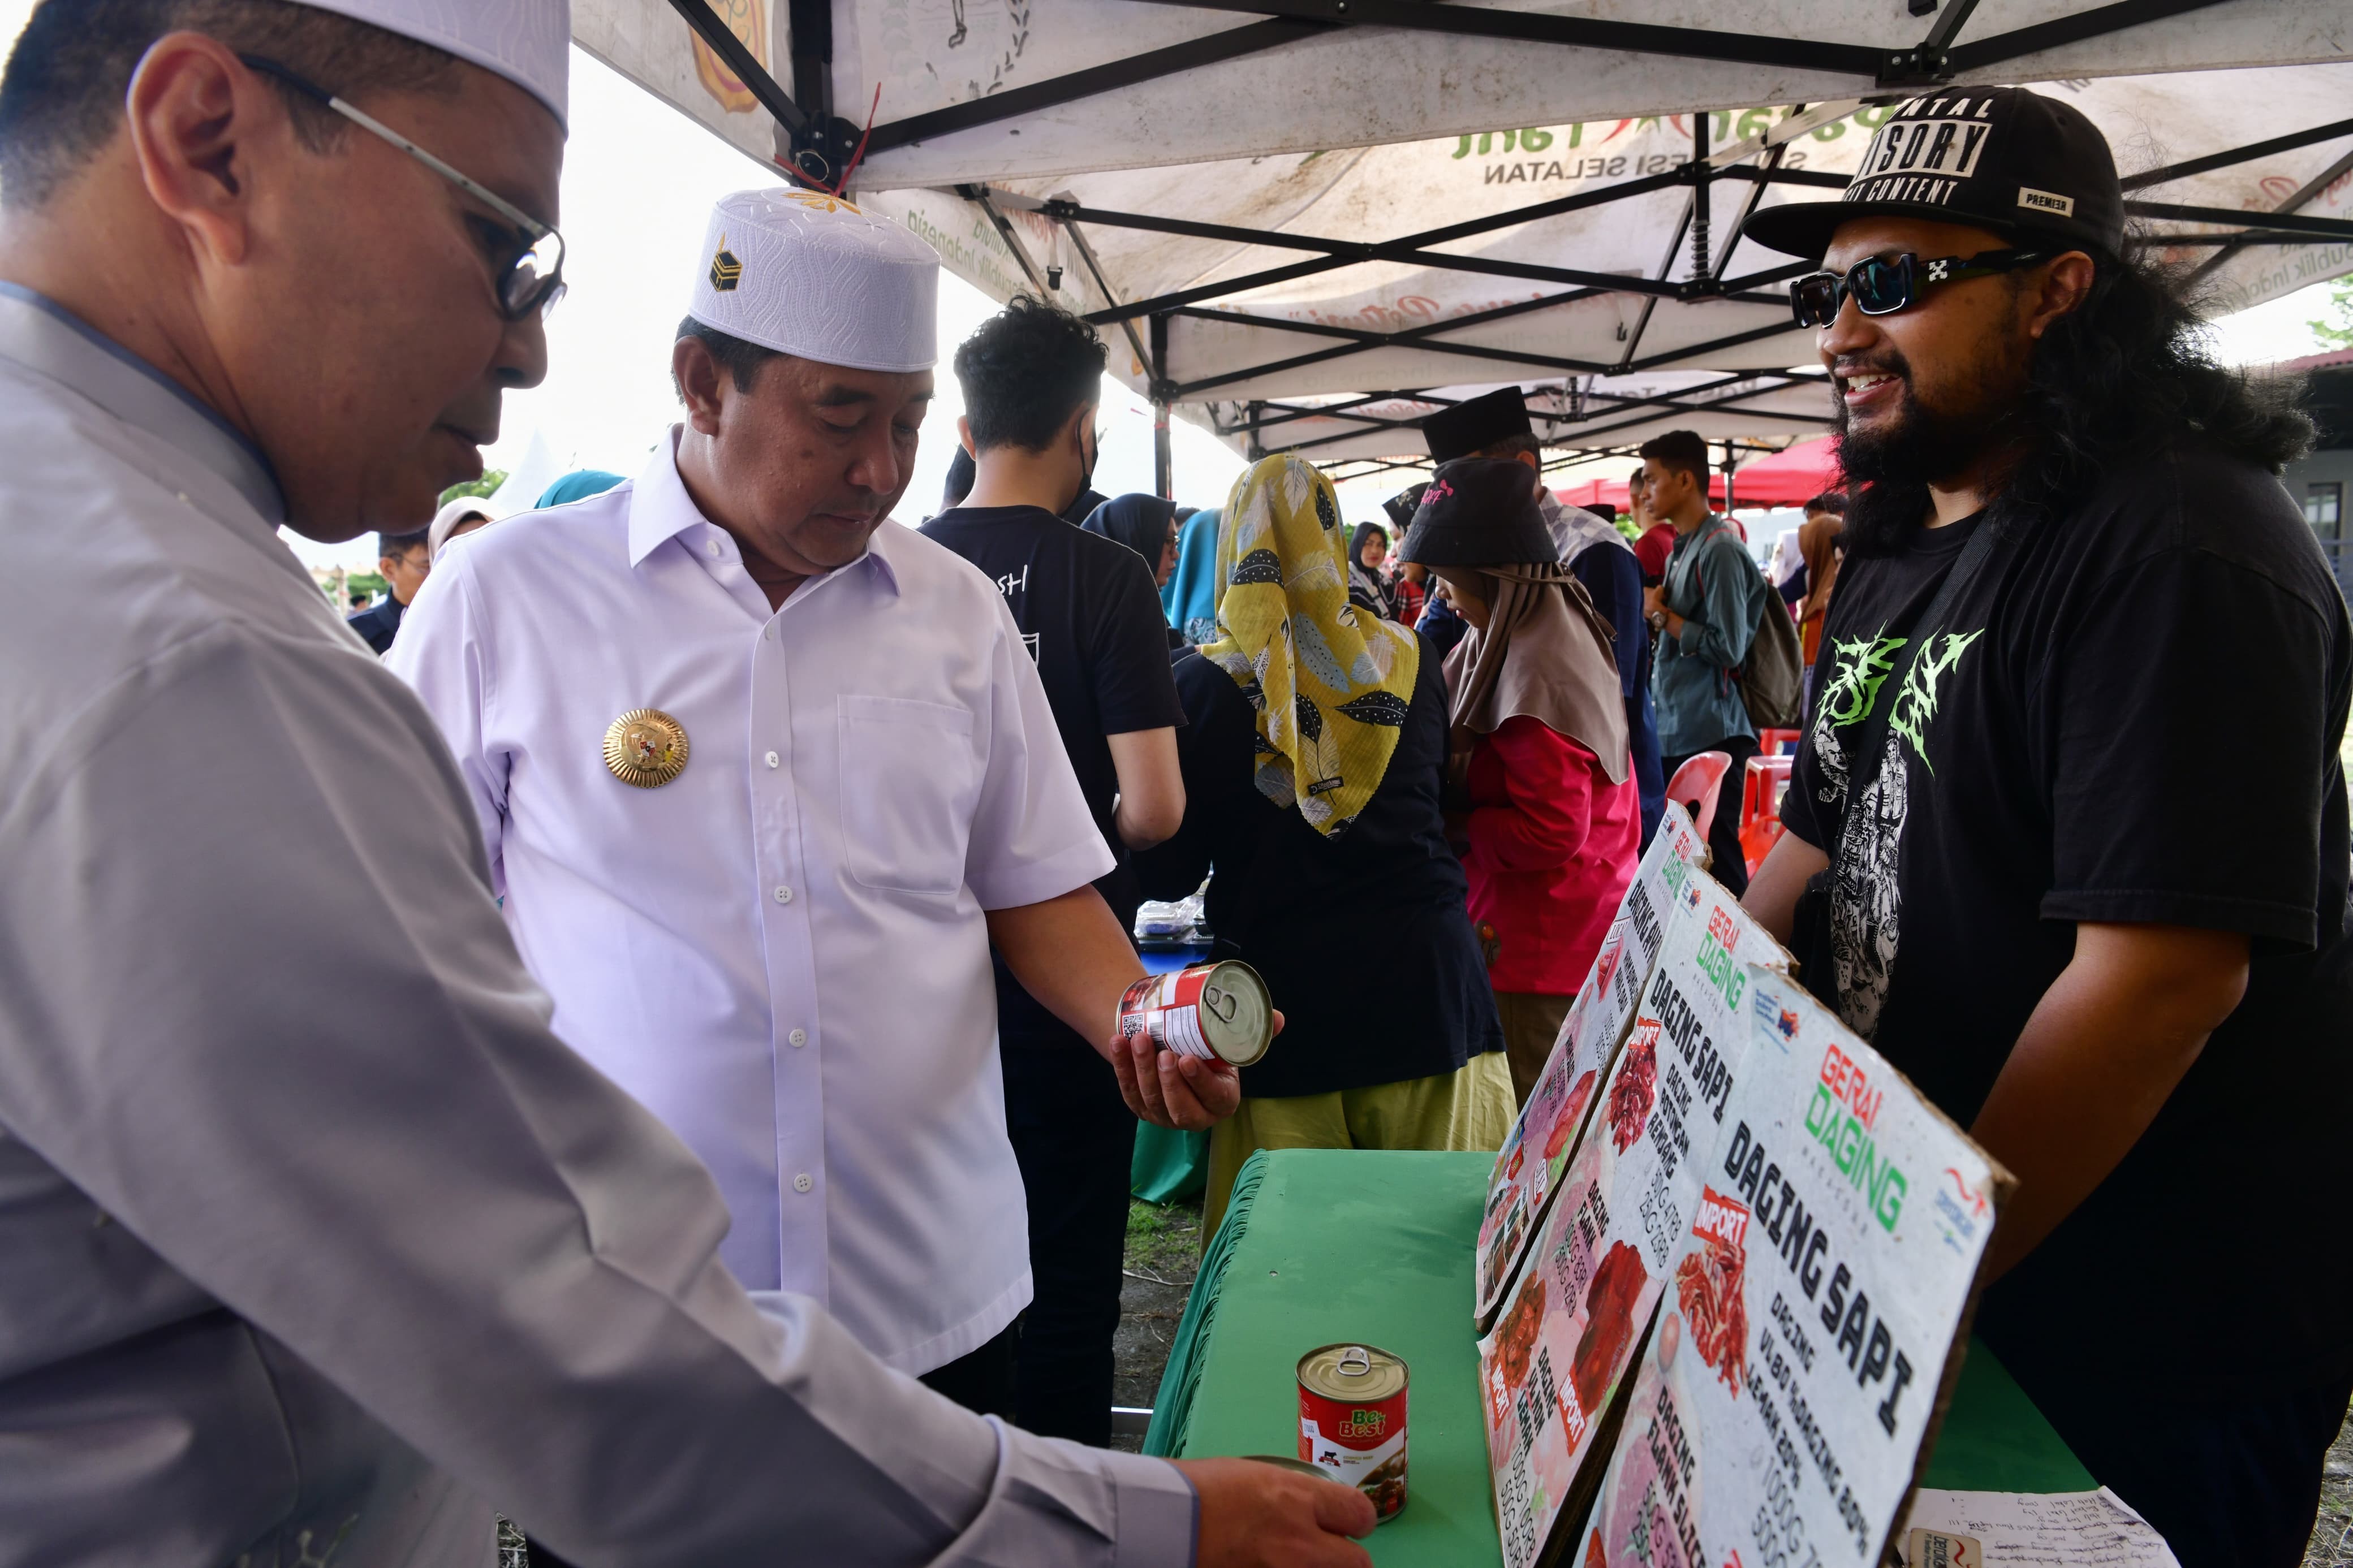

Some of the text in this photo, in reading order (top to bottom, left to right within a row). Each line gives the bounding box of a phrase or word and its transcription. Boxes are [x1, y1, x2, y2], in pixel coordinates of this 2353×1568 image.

[1901, 98, 1993, 118] NTAL
[1856, 123, 1986, 181] ISORY
[1866, 177, 1958, 205] CONTENT
[1643, 920, 1663, 971] AYA
[1708, 905, 1740, 955] GERAI
[1696, 931, 1746, 1011] DAGING
[1631, 1025, 1659, 1046] IMPORT
[1650, 967, 1733, 1125] DAGING SAPI
[1666, 1063, 1692, 1118] DAGING
[1821, 1043, 1882, 1133] GERAI
[1647, 1112, 1677, 1180] RENDANG
[1660, 1087, 1690, 1161] POTONGAN
[1804, 1081, 1907, 1233] DAGING
[1578, 1200, 1596, 1253] FLANK
[1588, 1178, 1610, 1238] DAGING
[1695, 1199, 1747, 1244] IMPORT
[1725, 1120, 1913, 1439] DAGING SAPI
[1771, 1291, 1816, 1373] DAGING
[1491, 1362, 1510, 1420] IMPORT
[1538, 1345, 1557, 1420] DAGING
[1559, 1374, 1585, 1443] IMPORT
[1747, 1363, 1781, 1440] LEMAK
[1340, 1420, 1385, 1437] Best
[1352, 1410, 1378, 1425] Be
[1518, 1389, 1534, 1459] LEMAK
[1657, 1384, 1695, 1488] DAGING
[1648, 1416, 1678, 1506] FLANK
[1501, 1479, 1516, 1530] 500G
[1512, 1444, 1536, 1561] 1000G 100RB
[1761, 1456, 1805, 1554] 1000G
[1934, 1536, 1950, 1568] berdika
